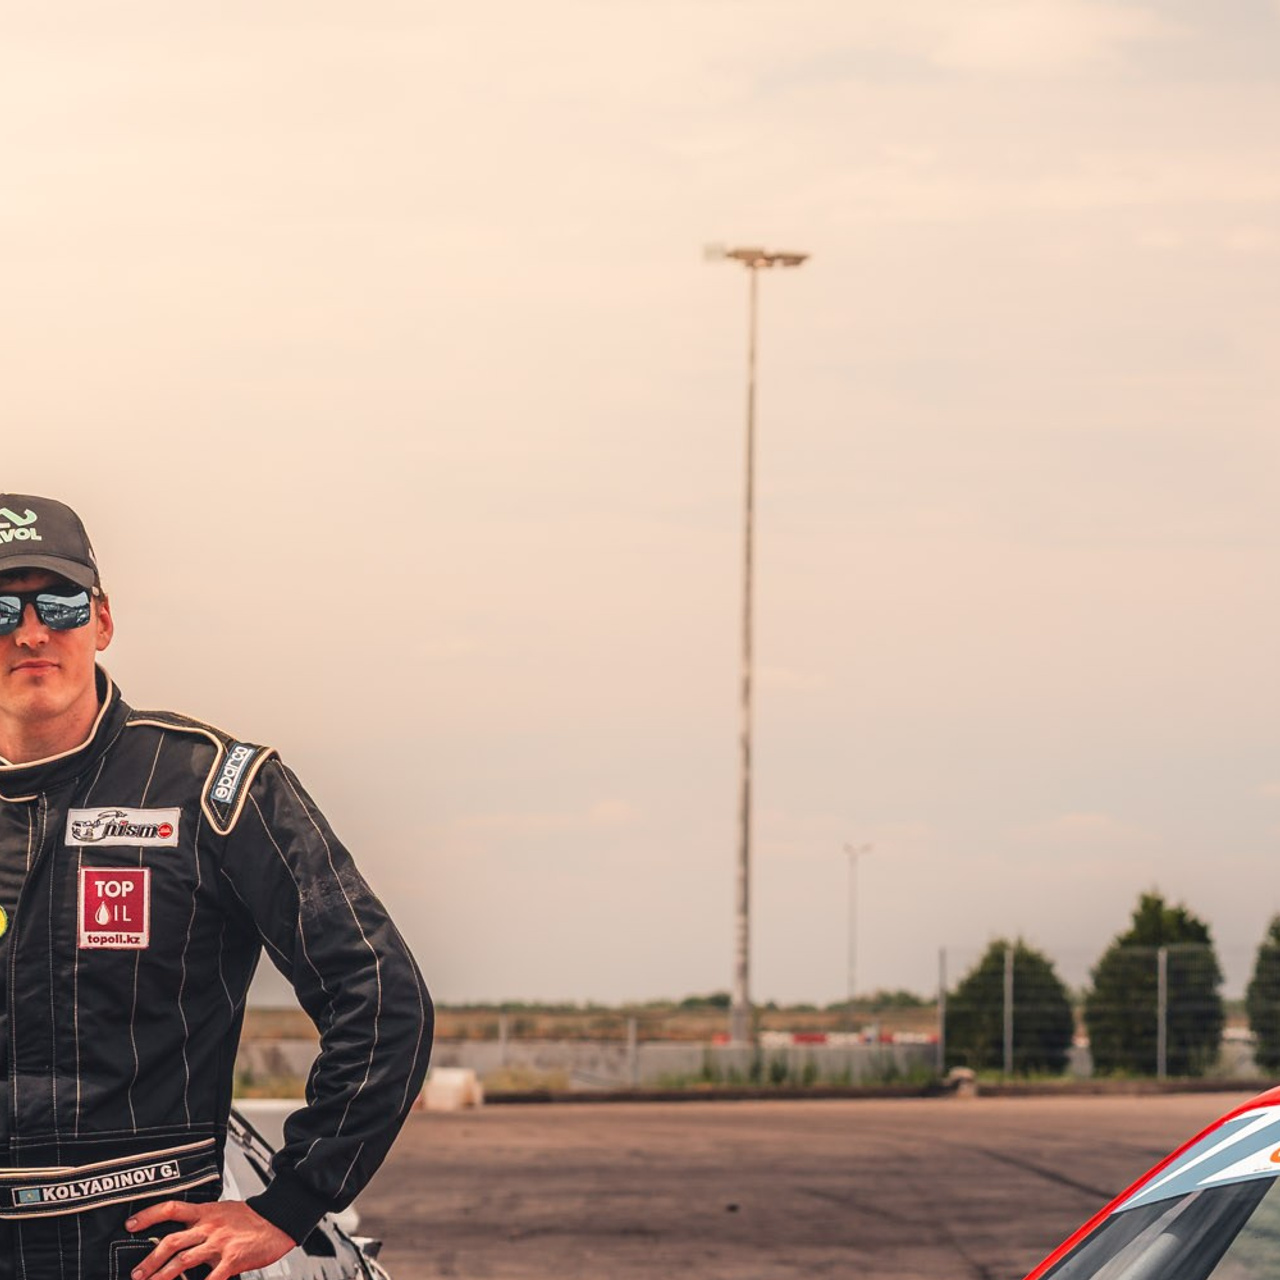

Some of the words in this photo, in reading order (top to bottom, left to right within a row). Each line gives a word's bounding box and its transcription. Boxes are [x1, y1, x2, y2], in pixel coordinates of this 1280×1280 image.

[0, 527, 42, 543] VOL
[94, 880, 134, 898] TOP
[87, 934, 141, 945] topoil.kz
[42, 1167, 156, 1201] KOLYADINOV
[160, 1164, 178, 1178] G.
